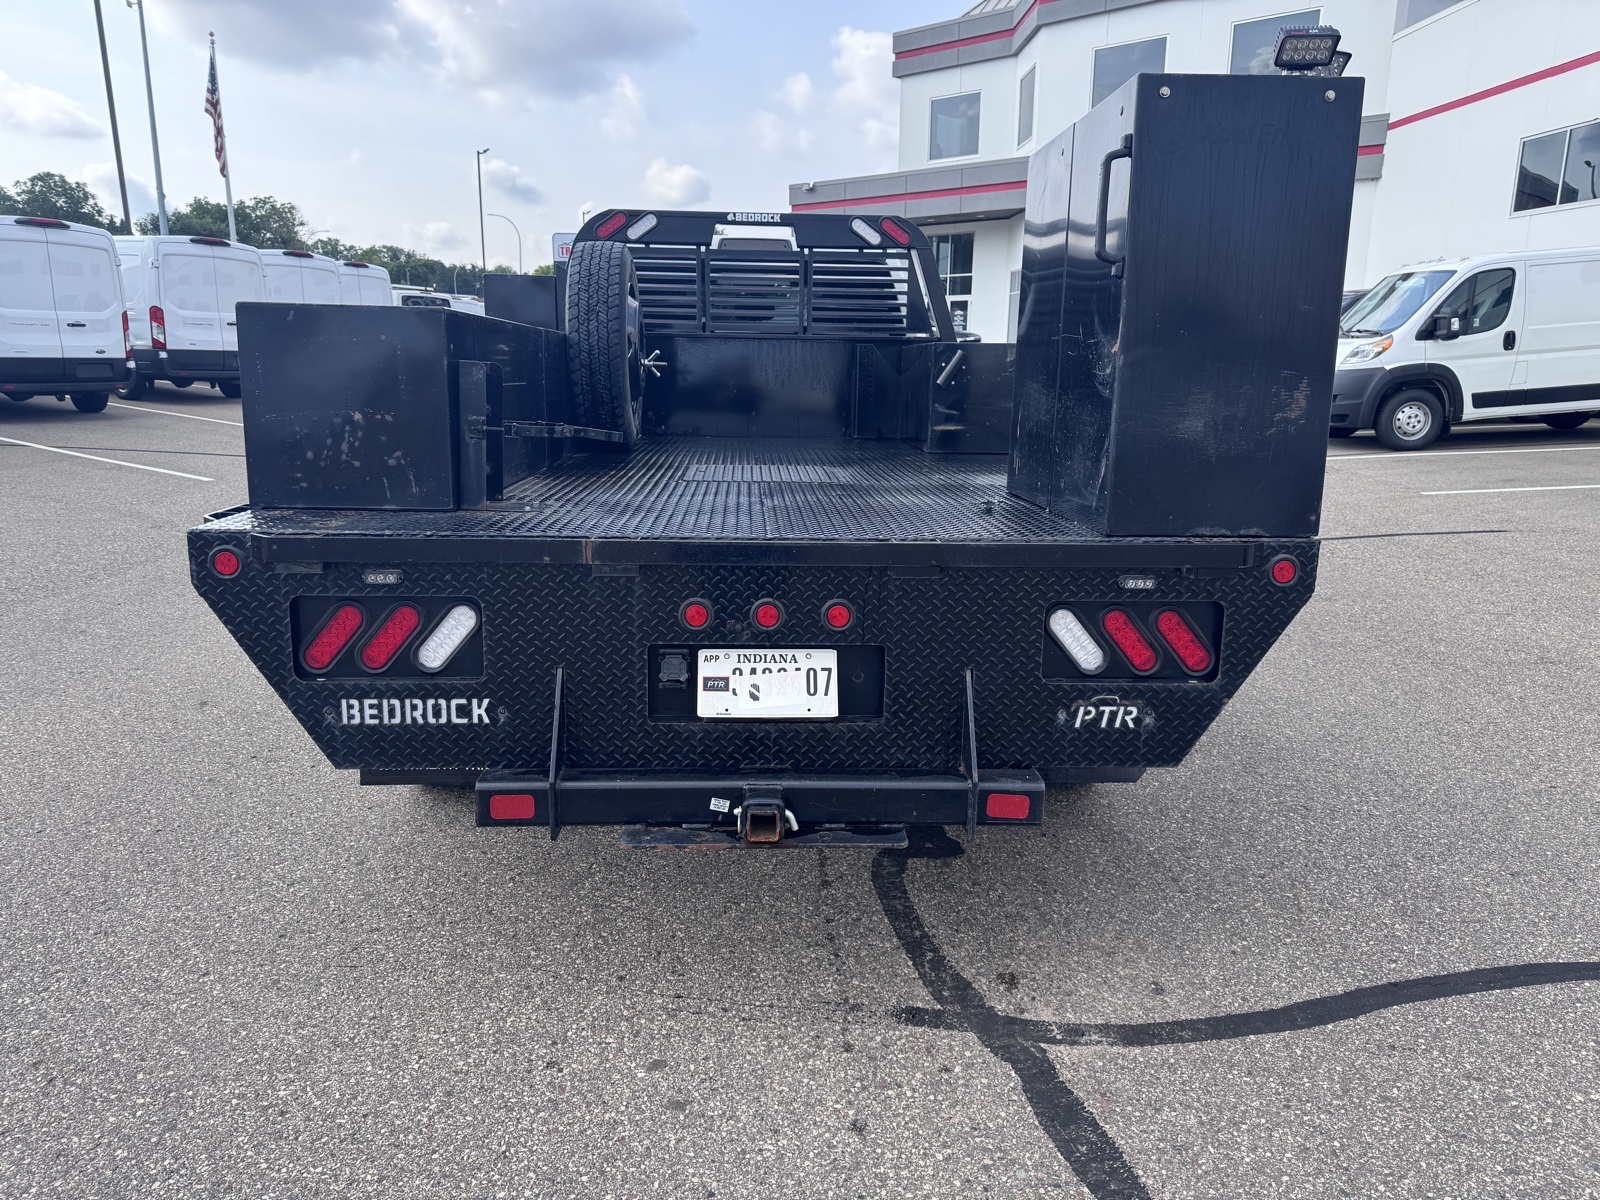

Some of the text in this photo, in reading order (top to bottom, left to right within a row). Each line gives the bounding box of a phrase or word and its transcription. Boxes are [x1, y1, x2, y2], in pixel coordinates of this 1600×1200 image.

[735, 212, 781, 223] BEDROCK
[703, 655, 720, 663] APP
[736, 653, 799, 664] INDIANA
[340, 698, 491, 725] BEDROCK
[1074, 705, 1138, 729] PTR
